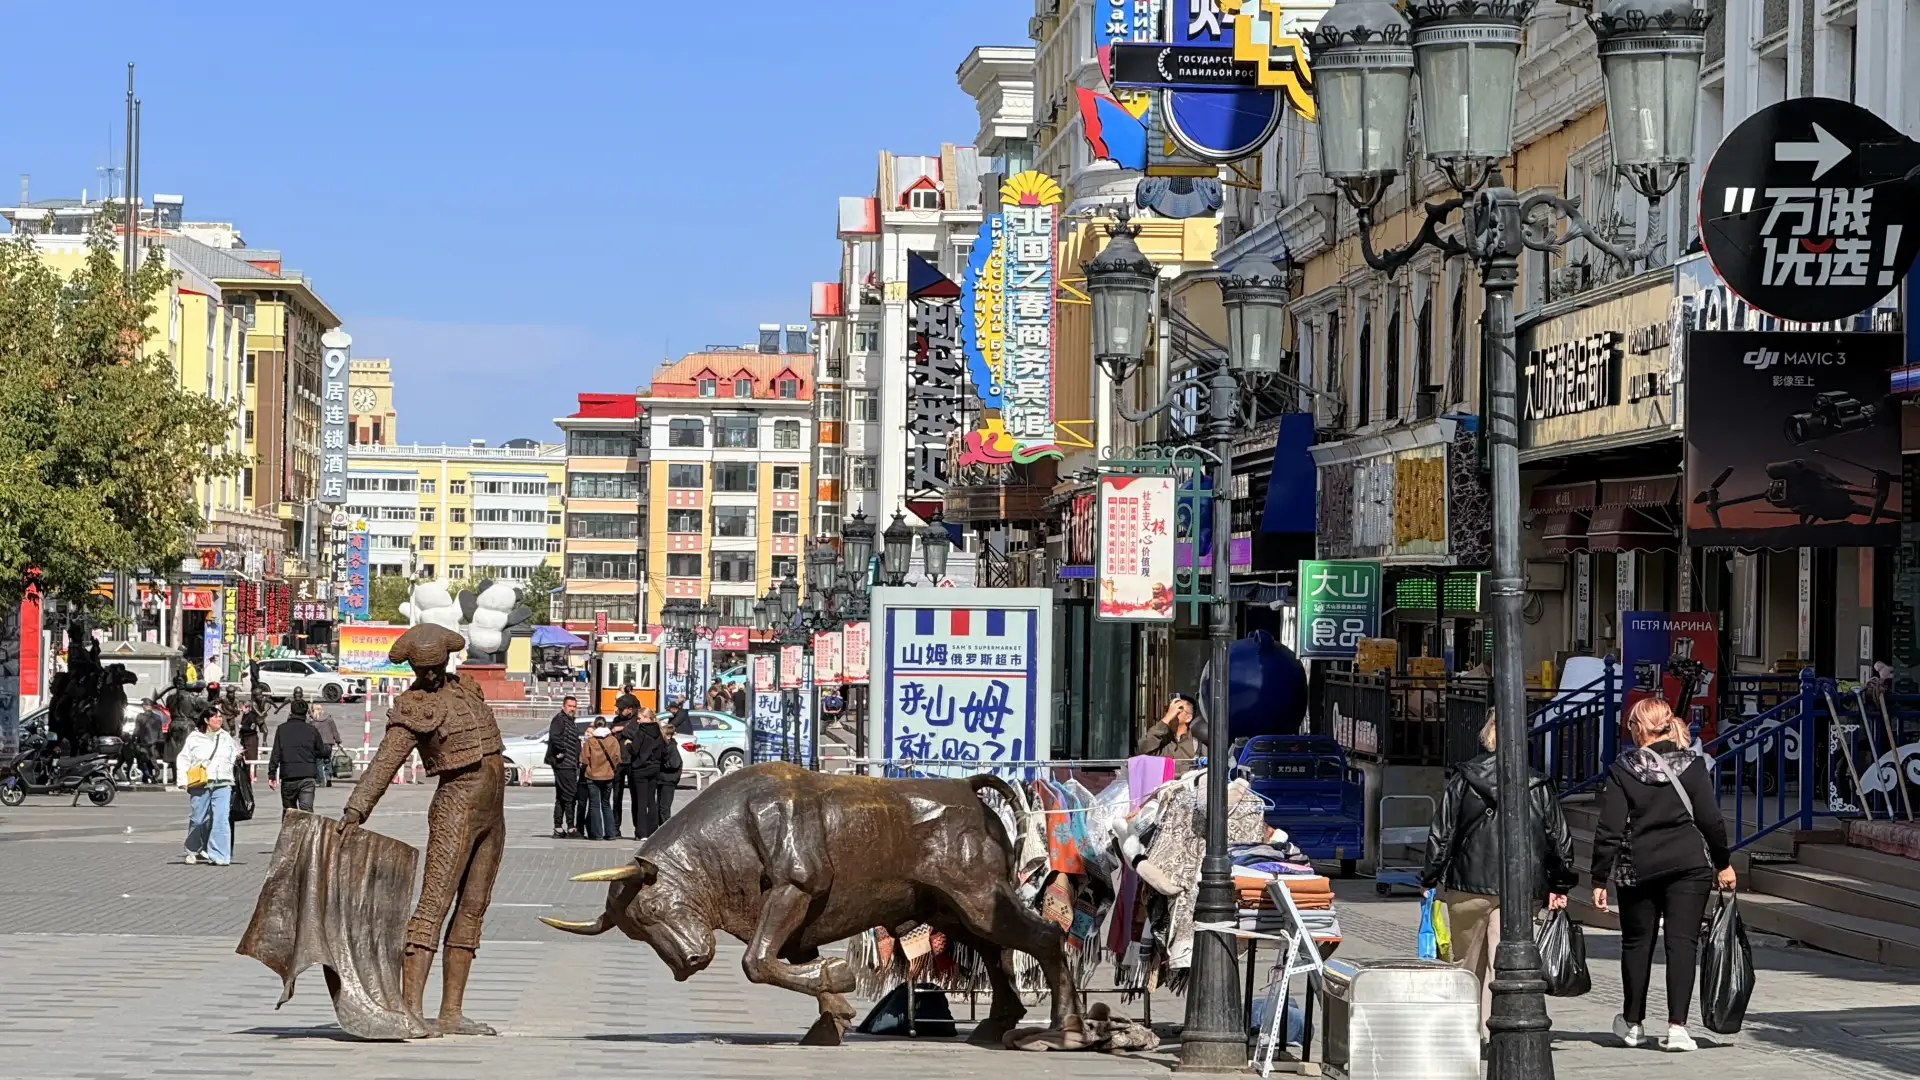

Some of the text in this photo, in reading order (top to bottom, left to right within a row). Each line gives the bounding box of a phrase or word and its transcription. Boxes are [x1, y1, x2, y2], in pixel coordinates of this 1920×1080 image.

[1179, 68, 1233, 76] ПАВИЛЬОН
[1014, 207, 1051, 436] 北国之春商务宾馆
[1784, 352, 1833, 365] MAVIC
[1836, 352, 1847, 365] 3
[1772, 375, 1816, 387] 影像至上
[323, 348, 347, 498] 9居连锁酒店
[1310, 568, 1369, 598] 大山
[1311, 617, 1367, 647] 食品
[1631, 620, 1713, 632] ПЕТЯ МАРИНА
[902, 643, 949, 666] 山姆
[951, 653, 1022, 666] 俄罗斯超市
[899, 680, 1014, 740] 来山姆
